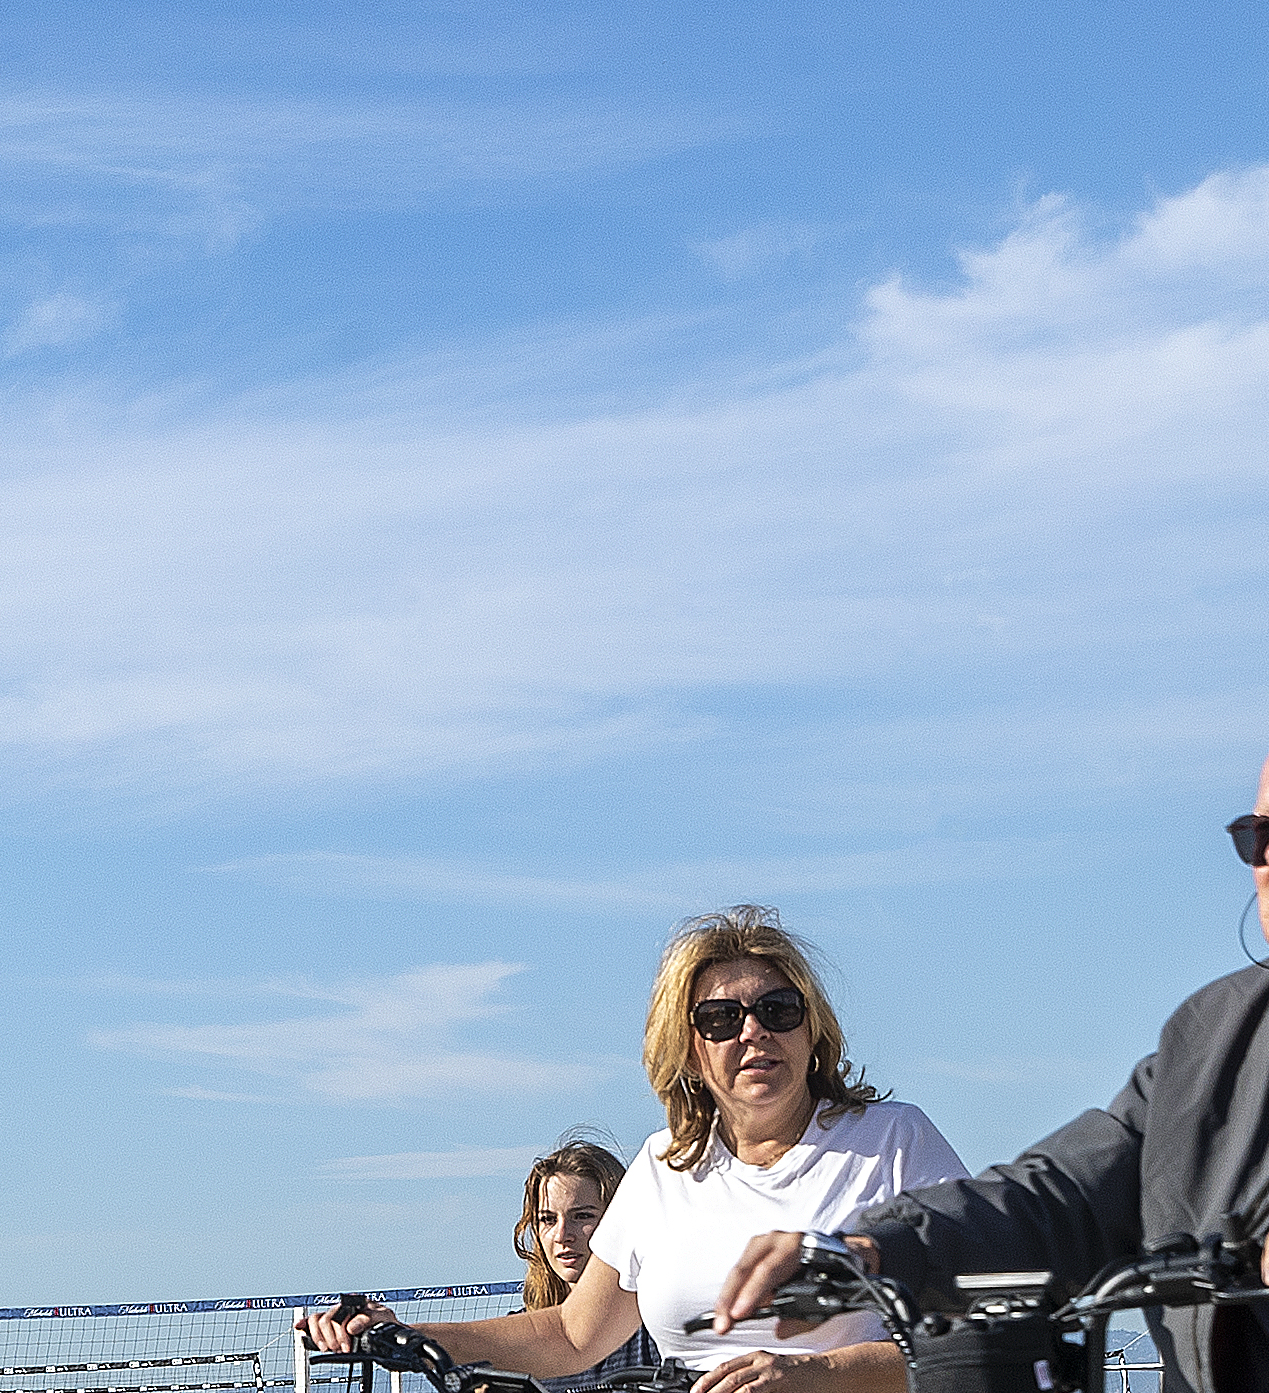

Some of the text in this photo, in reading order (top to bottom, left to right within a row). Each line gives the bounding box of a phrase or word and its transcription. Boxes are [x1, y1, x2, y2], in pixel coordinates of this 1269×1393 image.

[365, 1291, 387, 1302] TRA
[453, 1286, 488, 1297] ULTRA
[154, 1303, 188, 1313] ULTRA
[252, 1298, 286, 1309] ULTRA
[59, 1306, 92, 1317] ULTRA
